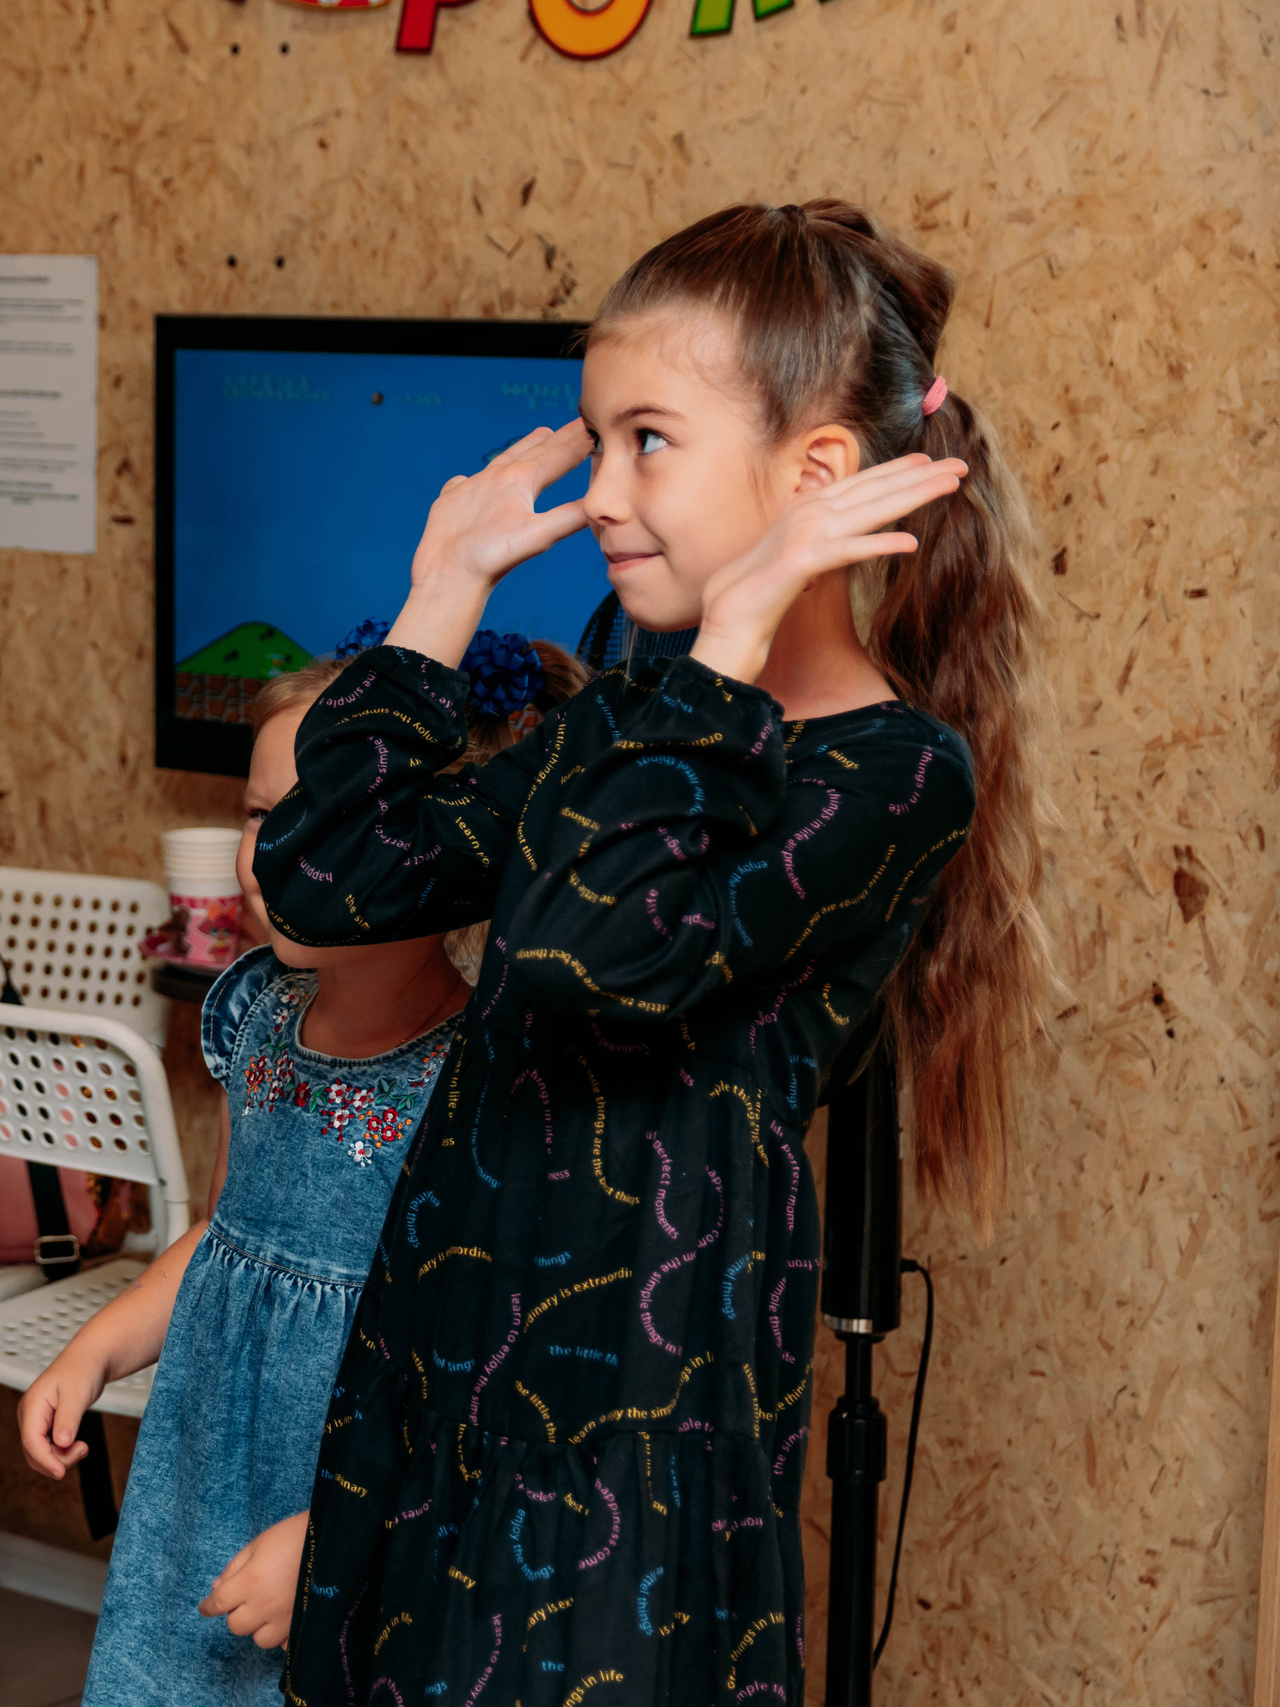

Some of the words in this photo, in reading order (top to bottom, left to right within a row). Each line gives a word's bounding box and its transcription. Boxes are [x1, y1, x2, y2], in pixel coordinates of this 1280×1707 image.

[325, 686, 365, 708] simple
[393, 709, 413, 724] the
[554, 721, 567, 751] little
[374, 738, 390, 774] simple
[535, 751, 560, 785] things
[636, 754, 677, 768] things
[914, 750, 933, 789] things
[888, 802, 911, 816] life
[909, 791, 922, 804] in
[455, 816, 481, 850] learn
[794, 826, 816, 842] life
[259, 841, 274, 852] the
[414, 844, 442, 867] erfect
[297, 854, 333, 883] happine
[738, 859, 768, 875] enjoy
[781, 849, 807, 900] priceless
[354, 914, 371, 932] sim
[516, 948, 548, 961] things
[548, 949, 572, 966] best
[448, 1090, 462, 1110] life
[709, 1080, 731, 1101] mple
[594, 1096, 608, 1135] things
[592, 1138, 604, 1156] are
[592, 1158, 604, 1177] the
[653, 1139, 673, 1186] perfect
[780, 1143, 801, 1191] perfect
[654, 1188, 680, 1239] moments
[786, 1196, 797, 1234] mome
[406, 1212, 420, 1248] things
[660, 1256, 682, 1273] the
[558, 1288, 573, 1300] is
[573, 1266, 632, 1293] extraordi
[640, 1271, 663, 1310] simple
[511, 1292, 522, 1326] learn
[722, 1281, 736, 1320] things
[640, 1311, 665, 1346] things
[769, 1276, 787, 1313] imple
[781, 1350, 796, 1365] ife
[507, 1328, 520, 1344] to
[484, 1344, 511, 1376] enjoy
[549, 1344, 573, 1356] the
[576, 1346, 604, 1361] little
[474, 1374, 490, 1394] the
[469, 1394, 481, 1427] simpl
[529, 1393, 551, 1420] little
[568, 1420, 597, 1445] learn
[626, 1406, 649, 1420] the
[689, 1354, 705, 1369] in
[773, 1452, 787, 1477] the
[401, 1500, 431, 1521] omes
[594, 1478, 620, 1546] happiness
[509, 1509, 526, 1540] enjoy
[512, 1543, 525, 1565] the
[577, 1547, 611, 1570] come
[546, 1601, 558, 1614] is
[636, 1597, 654, 1637] things
[491, 1613, 504, 1647] learn
[730, 1627, 758, 1663] things
[752, 1617, 768, 1632] in
[489, 1649, 501, 1664] to
[541, 1659, 565, 1672] the
[471, 1665, 494, 1701] enjoy
[581, 1674, 599, 1688] in
[599, 1667, 625, 1684] life
[737, 1680, 768, 1705] mple
